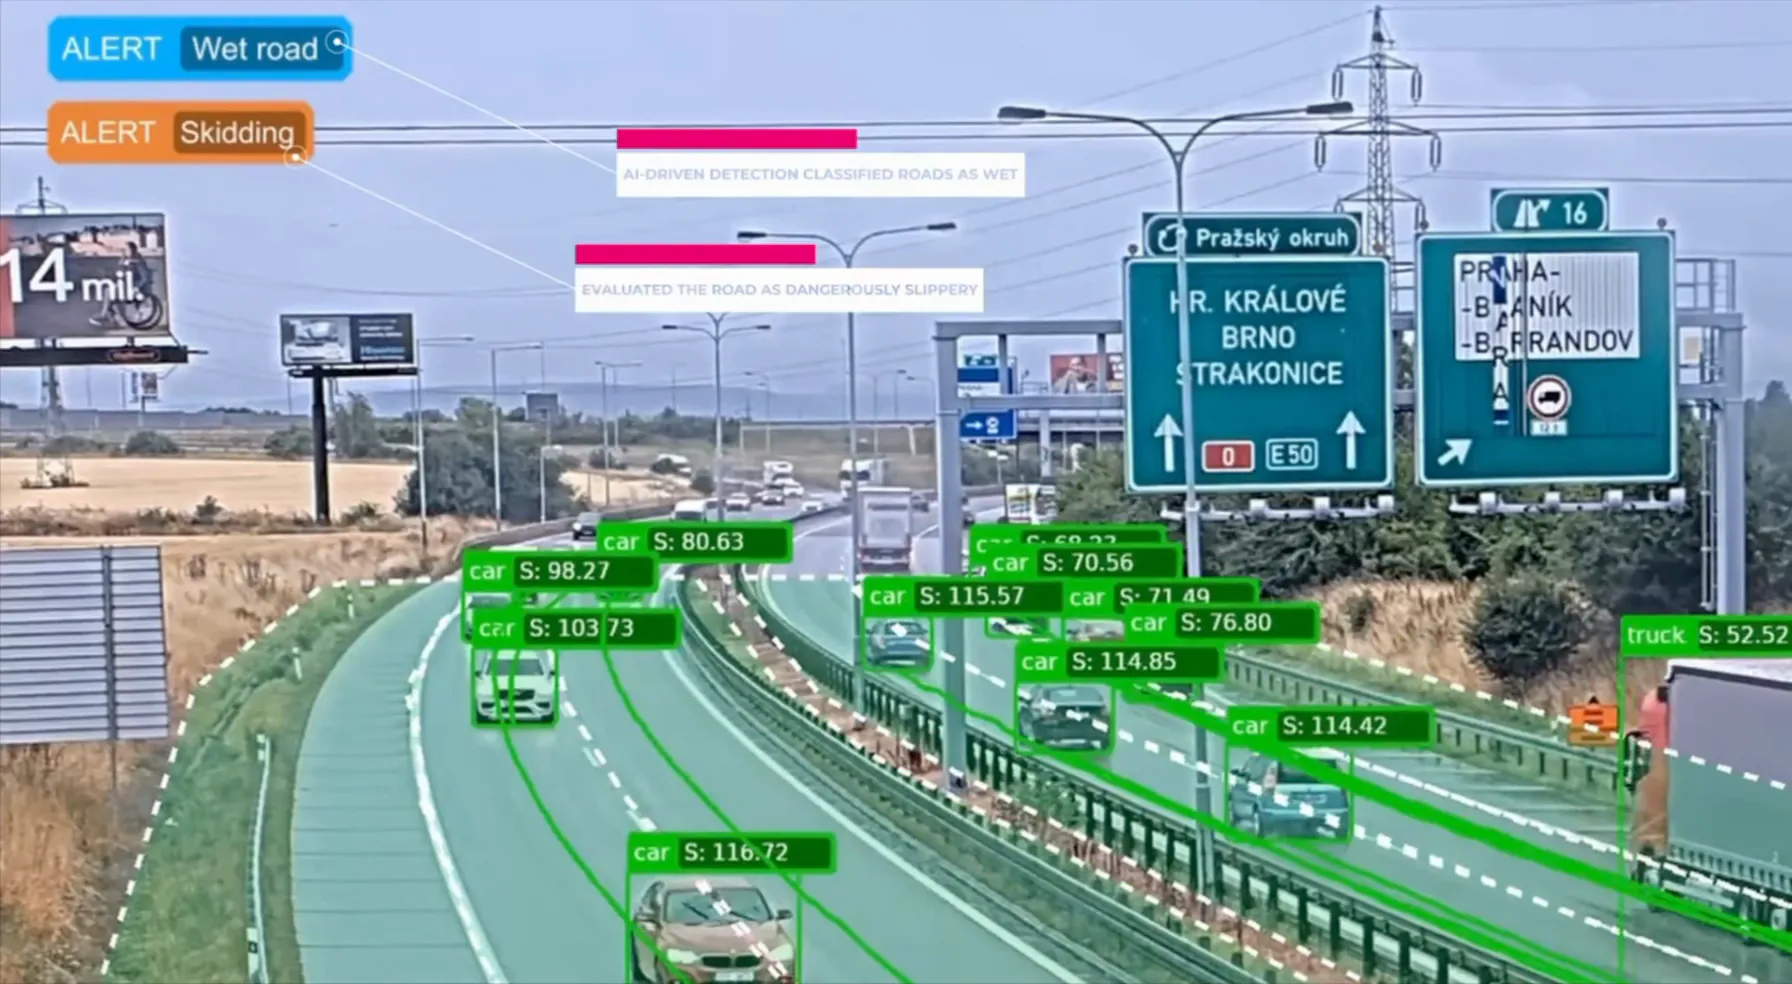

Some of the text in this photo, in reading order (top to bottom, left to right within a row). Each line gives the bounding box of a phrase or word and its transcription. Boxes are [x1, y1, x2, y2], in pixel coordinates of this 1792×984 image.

[1564, 202, 1588, 224] 16
[1196, 228, 1349, 251] Pražský okruh
[82, 270, 144, 302] mil.
[1170, 284, 1346, 313] HR. KRÁLOVÉ
[1461, 289, 1573, 318] -BANÍK
[1222, 326, 1296, 349] BRNO
[1461, 329, 1634, 354] -BRRANDOV
[1176, 361, 1343, 385] STRAKONICE
